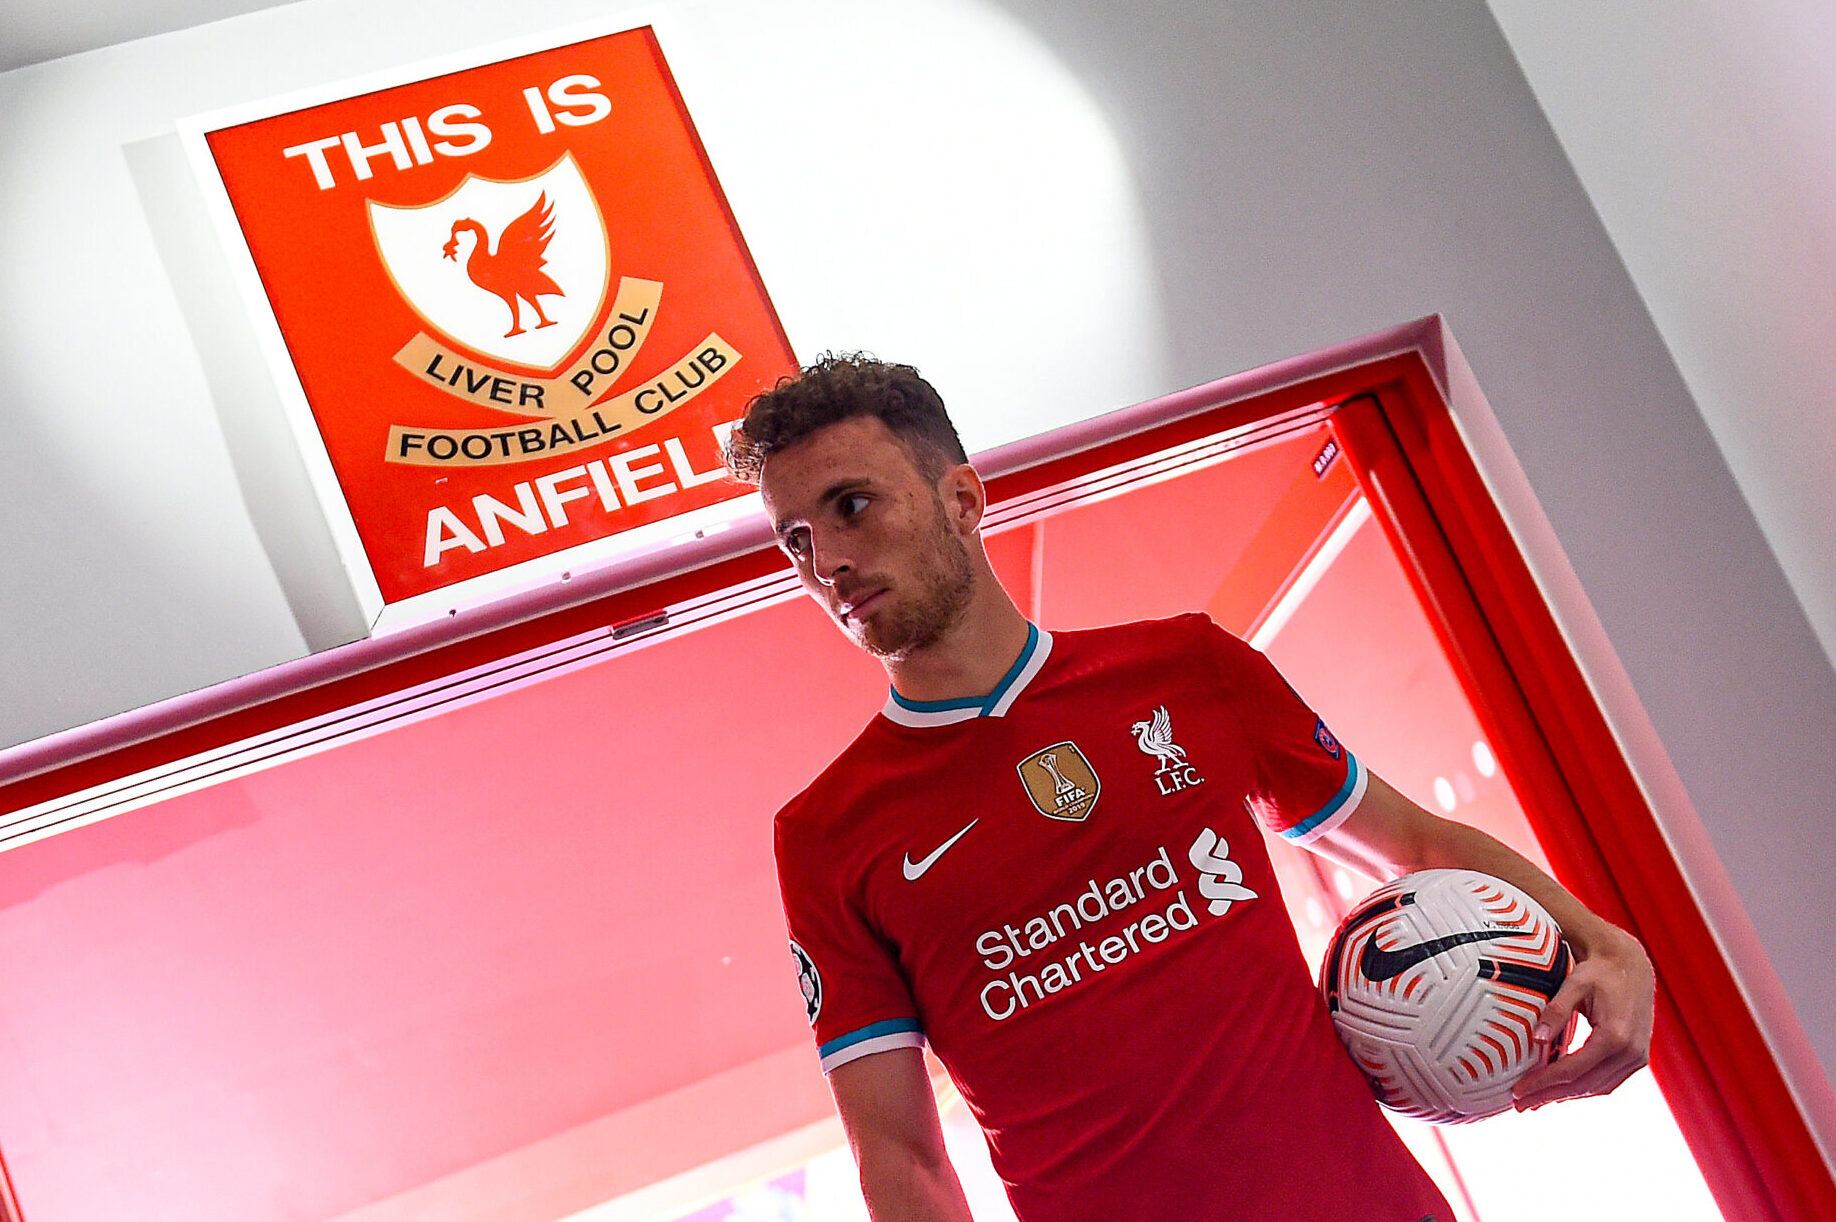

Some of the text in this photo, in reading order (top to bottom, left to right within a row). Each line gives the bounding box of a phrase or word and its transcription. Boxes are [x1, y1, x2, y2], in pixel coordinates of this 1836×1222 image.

[282, 74, 612, 190] THIS IS
[399, 346, 728, 460] FOOTBALL CLUB
[425, 307, 649, 409] LIVER POOL
[1055, 788, 1086, 807] FIFA
[975, 846, 1179, 970] Standard
[979, 890, 1199, 1021] Chartered
